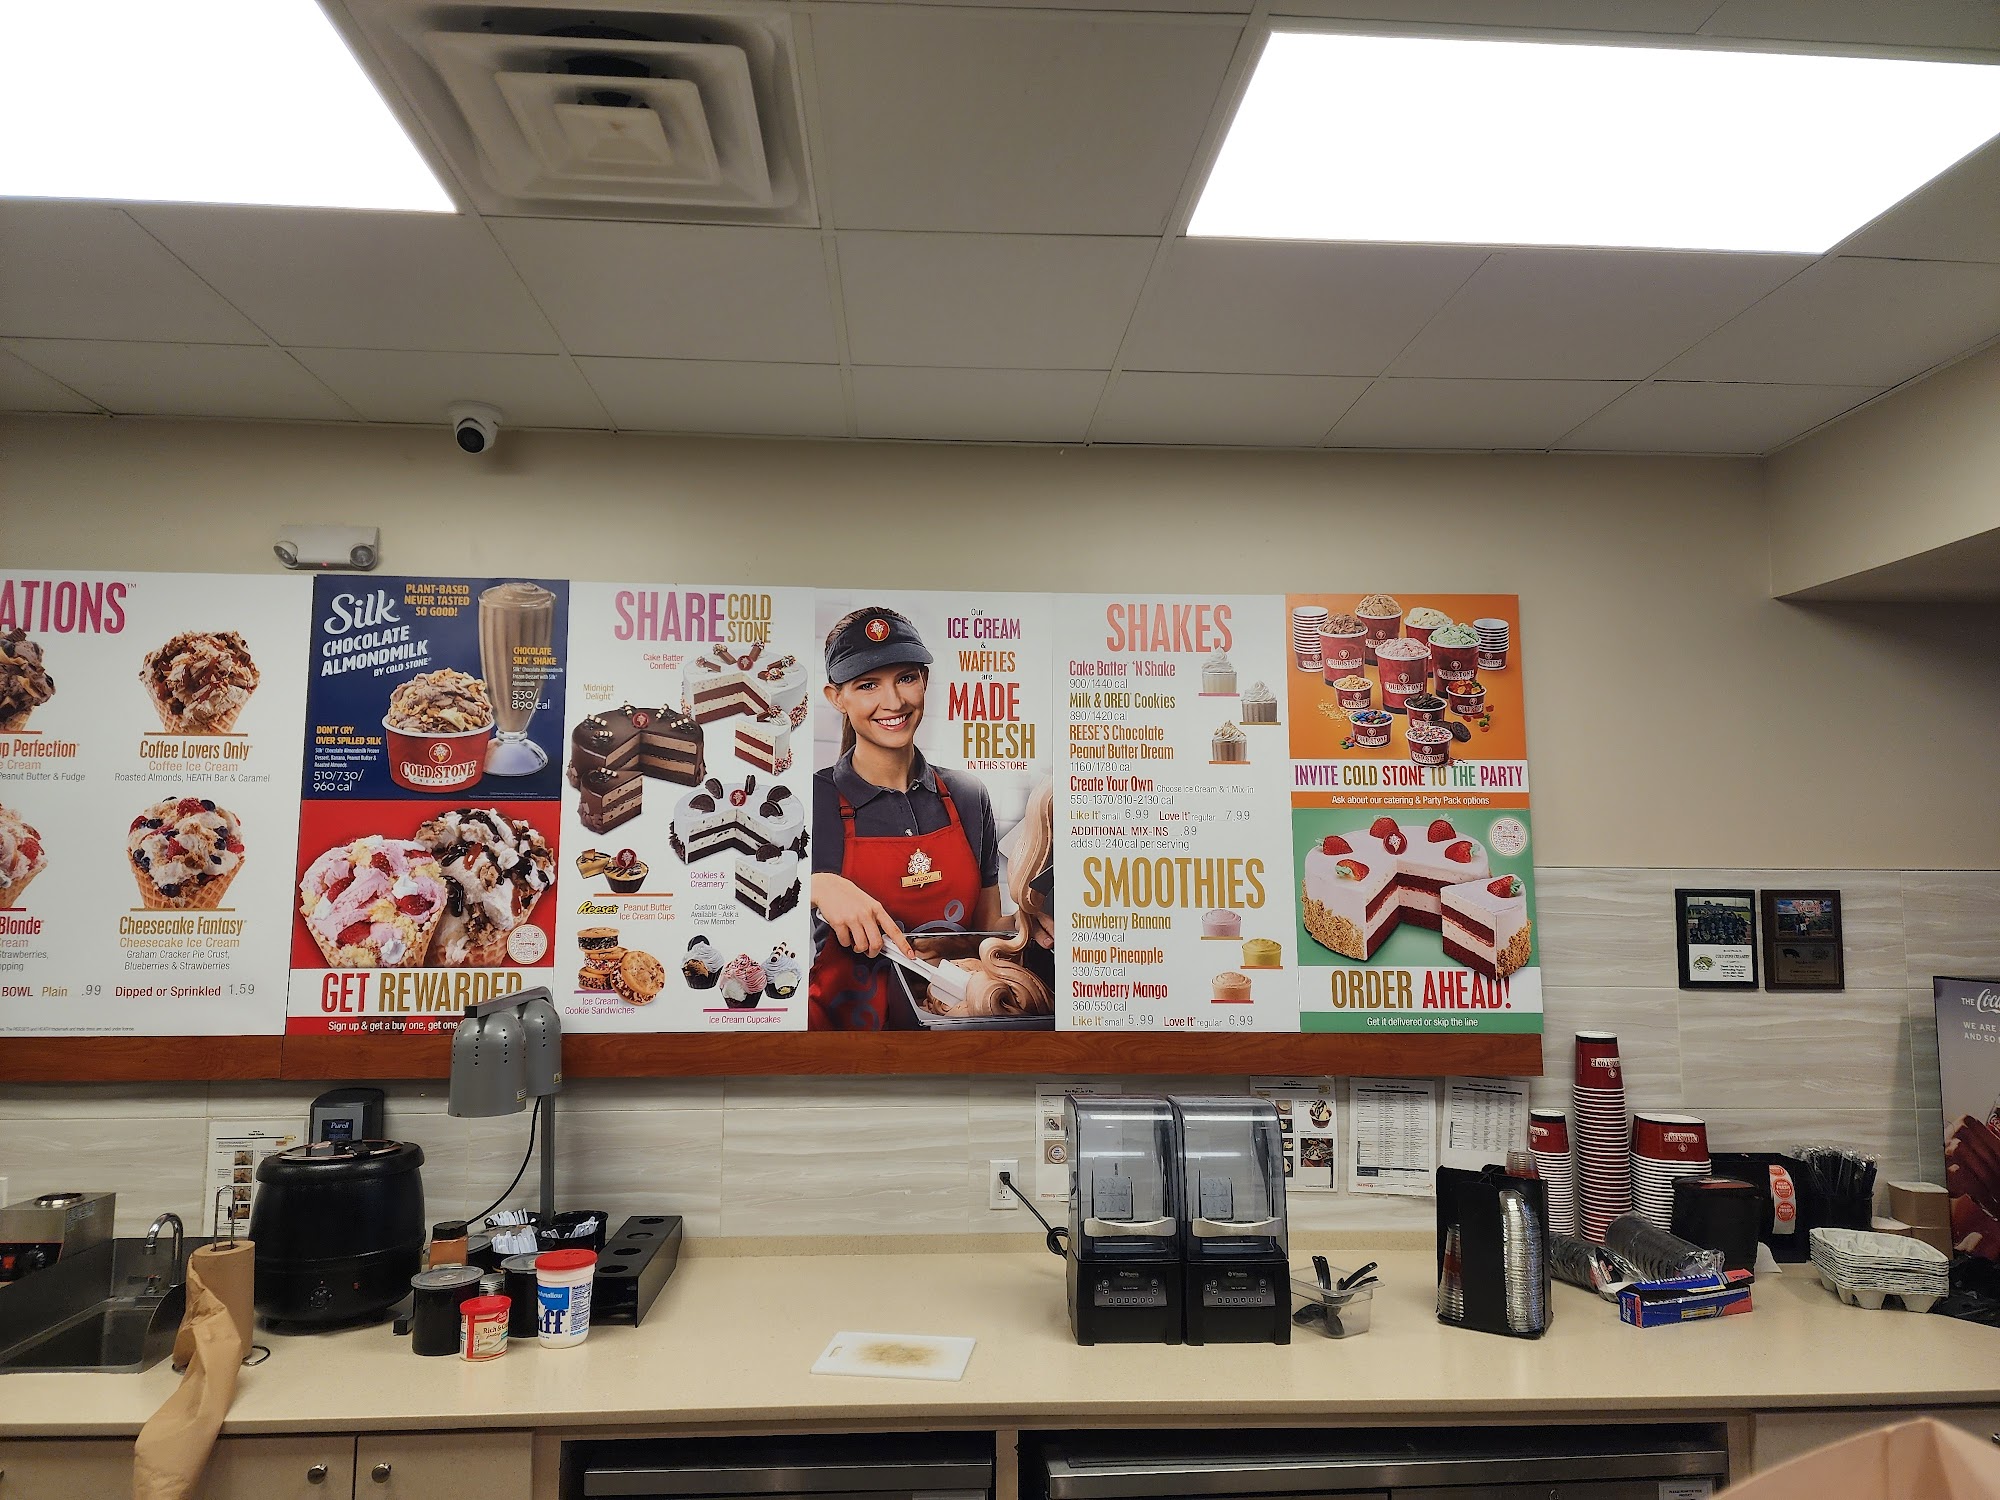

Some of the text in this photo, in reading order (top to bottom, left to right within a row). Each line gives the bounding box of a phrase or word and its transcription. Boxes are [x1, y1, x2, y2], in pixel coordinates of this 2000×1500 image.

[405, 584, 470, 595] PLANT-BASED
[404, 595, 470, 606] NEVER TASTED
[323, 590, 401, 635] Silk
[415, 606, 458, 617] SO GOOD!
[727, 593, 772, 621] COLD
[970, 608, 984, 616] Our
[614, 590, 725, 643] SHARE
[727, 621, 772, 644] STONE
[947, 617, 1021, 640] ICE CREAM
[1106, 603, 1233, 653] SHAKES
[322, 625, 410, 657] CHOCOLATE
[513, 646, 552, 656] CHOCOLATE
[321, 640, 429, 677] ALMONDMILK
[532, 656, 557, 666] SHAKE
[643, 653, 684, 662] Cake Batter
[958, 651, 1016, 673] WAFFLES
[385, 662, 404, 676] COLD
[1070, 660, 1176, 677] Cake Batter Shake
[583, 683, 615, 693] Midnight
[1069, 679, 1113, 689] 900/1440
[512, 688, 539, 701] 530/
[585, 692, 611, 701] Delight
[511, 700, 534, 711] 890
[948, 682, 1021, 722] MADE
[1069, 692, 1176, 709] Milk OREO Cookies
[316, 725, 355, 735] DON'T CRY
[1112, 725, 1164, 741] Chocolate
[315, 736, 382, 745] OVER SPILLED SILK
[963, 723, 1036, 759] FRESH
[13, 740, 76, 758] Perfection
[139, 740, 250, 761] Coffee Lovers Only
[1069, 743, 1174, 760] Peanut Butter Dream
[149, 761, 238, 772] Coffee Cream
[977, 761, 1028, 771] THIS STORE
[1070, 761, 1118, 772] 1160/1780
[61, 772, 86, 783] Fudge
[114, 772, 270, 784] Roasted Almonds, HEATH Bar Caramel
[314, 769, 365, 782] 510/730/
[1295, 765, 1523, 787] INVITE COLD STONE TO THE PARTY
[313, 780, 353, 792] 960 cal
[1070, 775, 1104, 792] Create
[1105, 775, 1129, 792] Your
[1130, 775, 1154, 792] Own
[1331, 796, 1490, 807] Ask about our catering Party Pack options
[1070, 811, 1090, 821] Like
[1124, 809, 1150, 820] 6.99
[1159, 811, 1180, 821] Love
[1070, 826, 1169, 837] ADDITIONAL MIX-INS
[1070, 838, 1093, 849] adds
[1124, 838, 1138, 849] cal
[1156, 839, 1190, 851] serving
[690, 871, 719, 880] Cookies
[690, 880, 726, 890] Creamery
[1082, 856, 1266, 909] SMOOTHIES
[623, 903, 673, 912] Peanut Butter
[694, 903, 737, 911] Custom Cakes
[631, 912, 676, 922] Cream Cups
[710, 918, 736, 926] Member
[1071, 913, 1171, 931] Strawberry Banana
[119, 916, 244, 937] Cheesecake Fantasy
[120, 938, 240, 948] Cheesecake Ice Cream
[1071, 932, 1112, 943] 280/490
[126, 950, 205, 960] Graham Cracker Pie
[1072, 947, 1164, 966] Mango Pineapple
[124, 961, 231, 971] Blueberries Strawberries
[1072, 966, 1112, 977] 330/570
[1, 986, 34, 998] BOWL
[41, 986, 68, 998] Plain
[115, 986, 154, 999] Dipped
[155, 988, 168, 998] or
[170, 986, 222, 999] Sprinkled
[228, 984, 256, 997] 1.59
[321, 972, 370, 1013] GET
[1072, 981, 1168, 1000] Strawberry Mango
[1331, 970, 1512, 1009] ORDER AHEAD!
[595, 997, 619, 1006] Cream
[1072, 1001, 1112, 1012] 360/550
[1961, 997, 1975, 1006] THE
[564, 1006, 635, 1015] Cookie Sandwiches
[722, 1015, 781, 1025] Cream Cupcakes
[1072, 1015, 1254, 1027] Like 5.99 Love 6.99
[1367, 1017, 1478, 1028] Get delivered skip the line
[328, 1021, 458, 1033] Sign up get buy get one
[1963, 1021, 1997, 1032] WE ARE
[1964, 1032, 1996, 1043] AND SO
